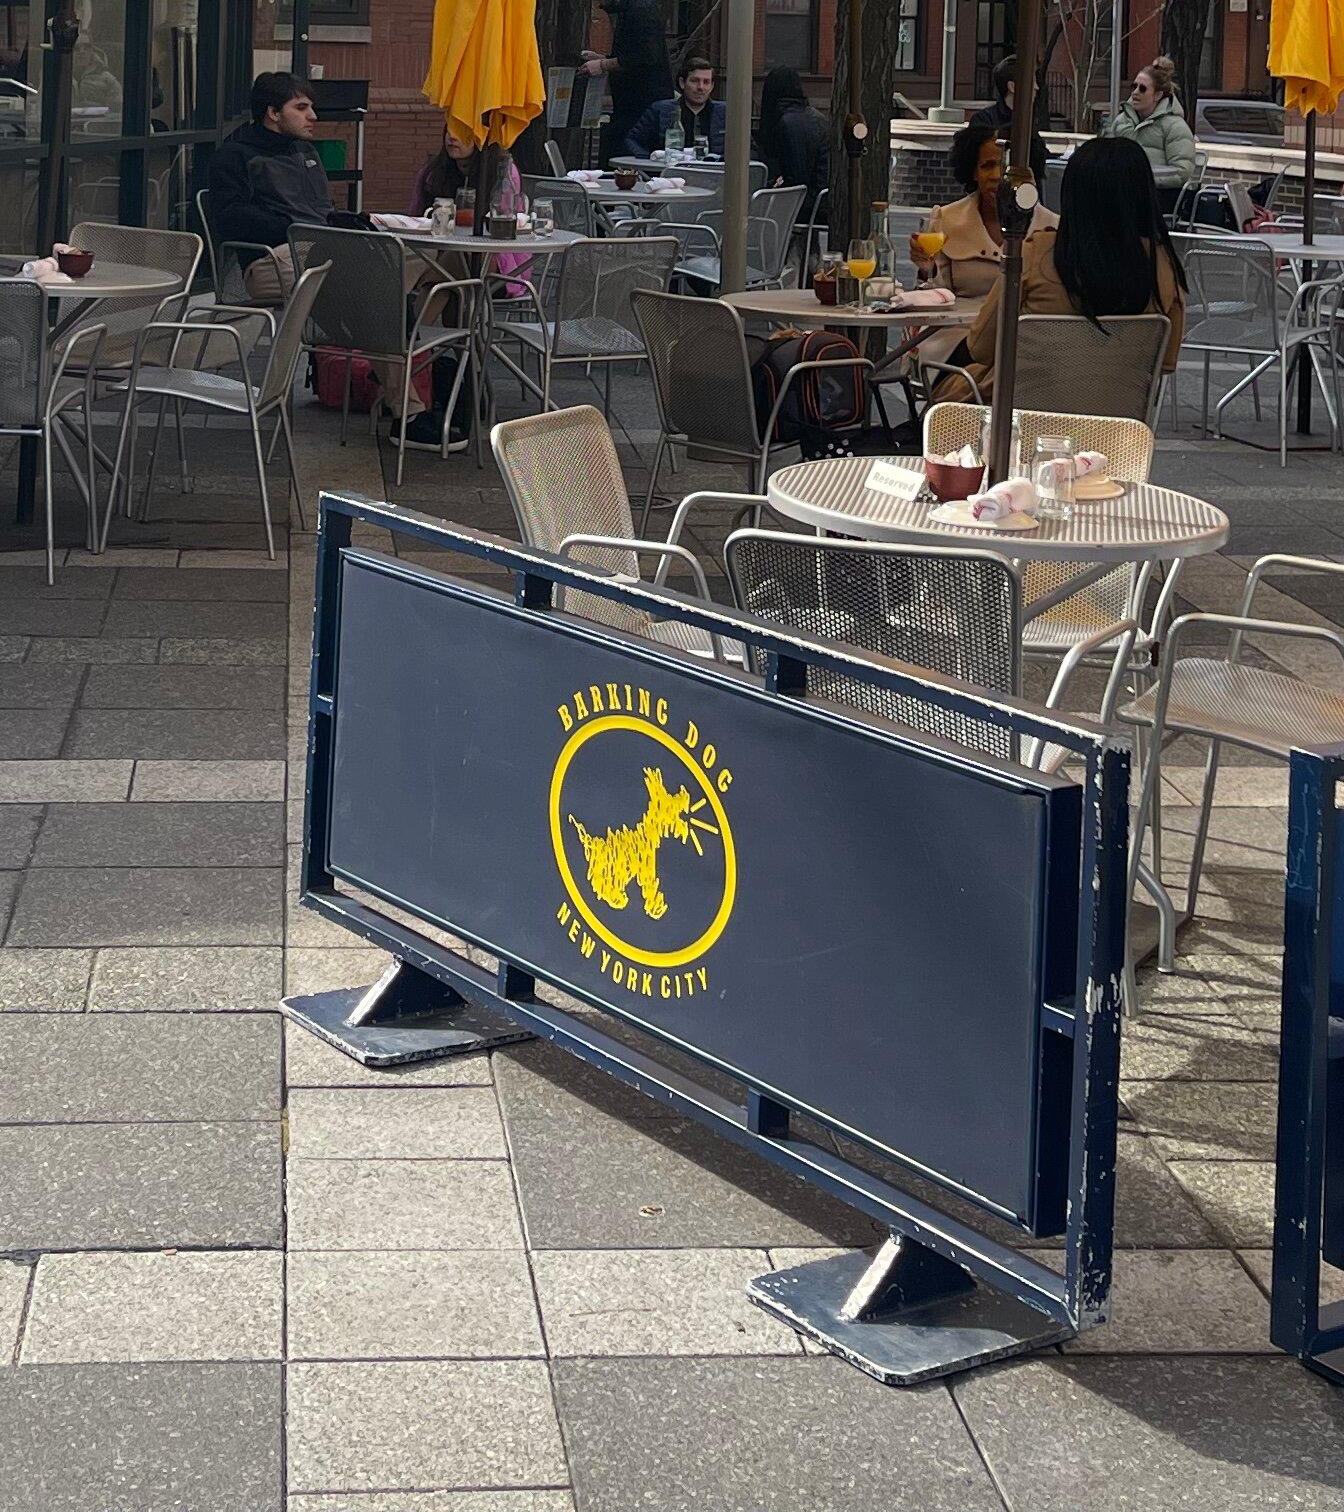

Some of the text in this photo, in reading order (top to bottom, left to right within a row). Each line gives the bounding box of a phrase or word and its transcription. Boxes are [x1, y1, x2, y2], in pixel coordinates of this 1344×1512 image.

[873, 472, 915, 492] Reserved
[557, 682, 734, 792] BARKING DOG
[556, 901, 708, 999] NEW YORK CITY
